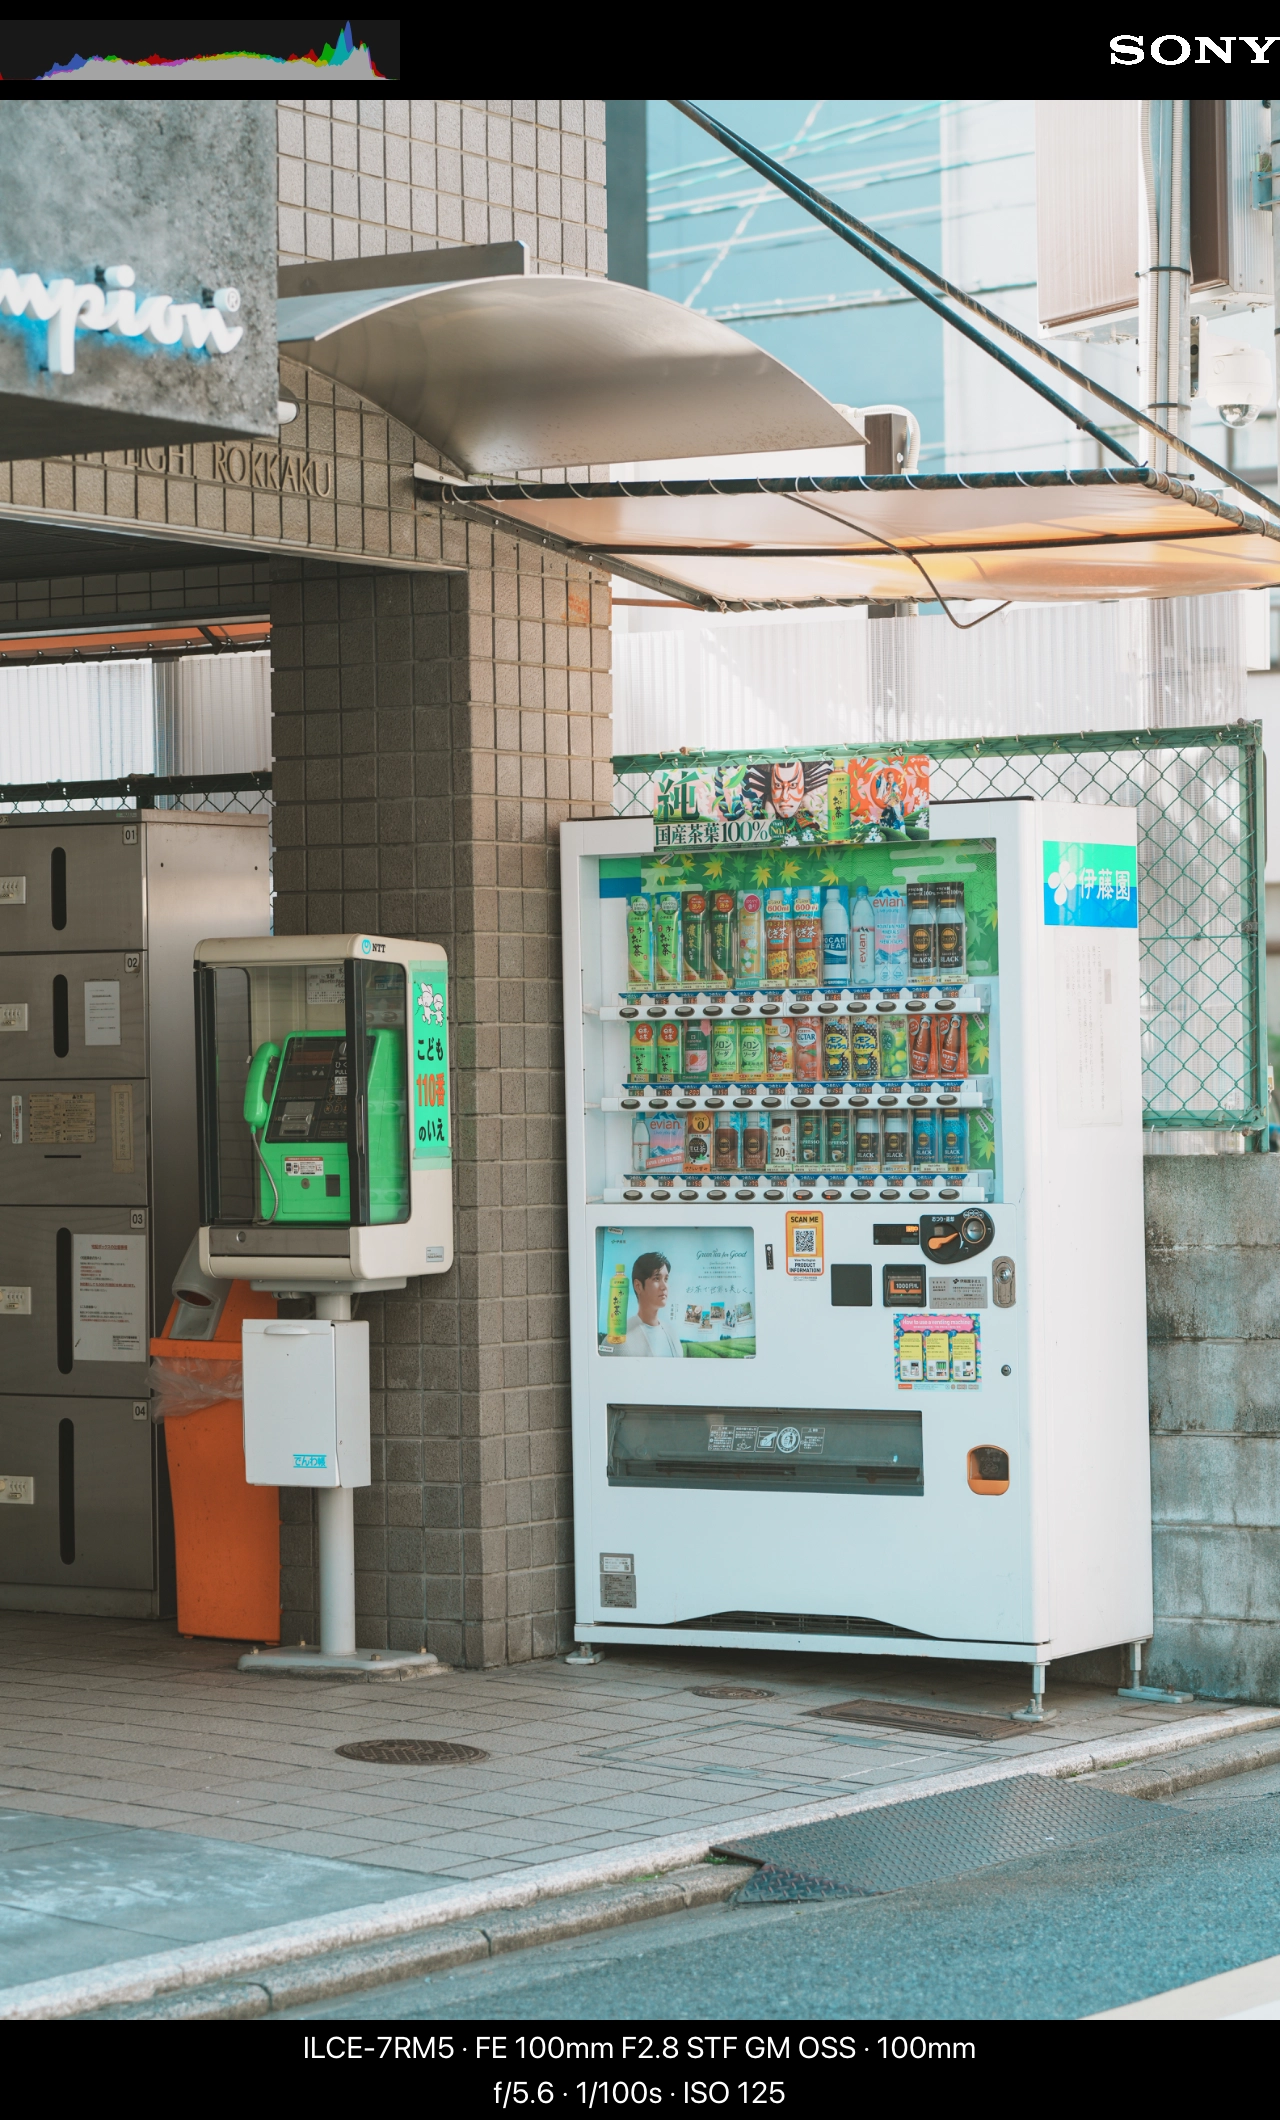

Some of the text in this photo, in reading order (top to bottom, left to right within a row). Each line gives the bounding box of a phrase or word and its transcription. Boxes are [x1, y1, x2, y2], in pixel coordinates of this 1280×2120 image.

[213, 442, 331, 497] ROKKAKU
[657, 771, 700, 822] 純
[125, 829, 136, 841] 01
[655, 820, 769, 846] 国産茶葉100%
[1079, 866, 1131, 902] 伊藤園
[767, 927, 788, 939] むぎ茶
[795, 926, 817, 938] むぎ茶
[372, 943, 386, 953] NTT
[859, 933, 867, 963] evian
[126, 957, 138, 969] 02
[417, 1036, 444, 1061] こども
[714, 1041, 732, 1049] メロン
[742, 1041, 759, 1049] メロン
[416, 1072, 446, 1107] 110番
[418, 1117, 445, 1142] のいえ
[775, 1148, 785, 1157] 20
[131, 1213, 143, 1225] 03
[696, 1250, 712, 1260] Green
[712, 1248, 721, 1258] Tea
[729, 1250, 748, 1260] Good
[135, 1405, 146, 1417] 04
[293, 1455, 326, 1467] でんわ帳
